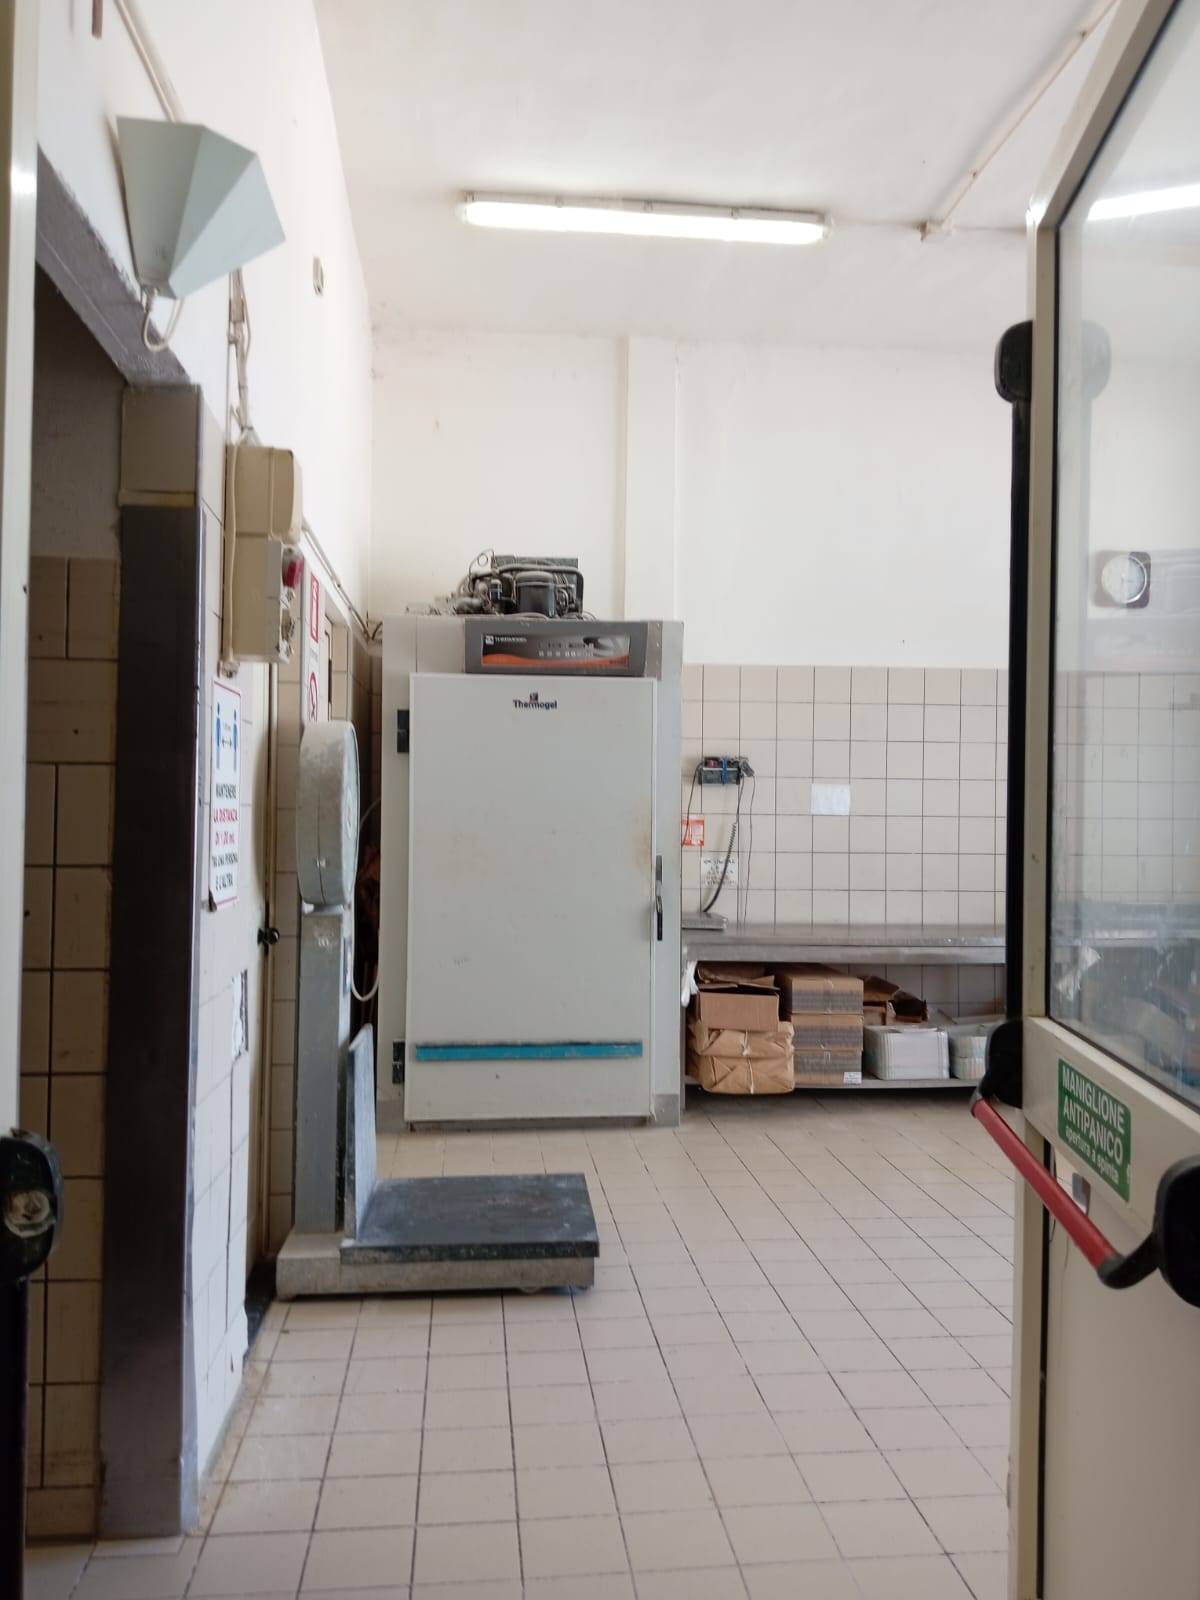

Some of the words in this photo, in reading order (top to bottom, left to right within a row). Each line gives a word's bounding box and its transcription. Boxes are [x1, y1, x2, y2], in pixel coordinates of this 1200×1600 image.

[512, 699, 557, 710] Thermogel
[1062, 1065, 1125, 1135] MANIGLIONE
[1063, 1095, 1123, 1166] ANTIPANICO
[1065, 1126, 1090, 1158] apertura
